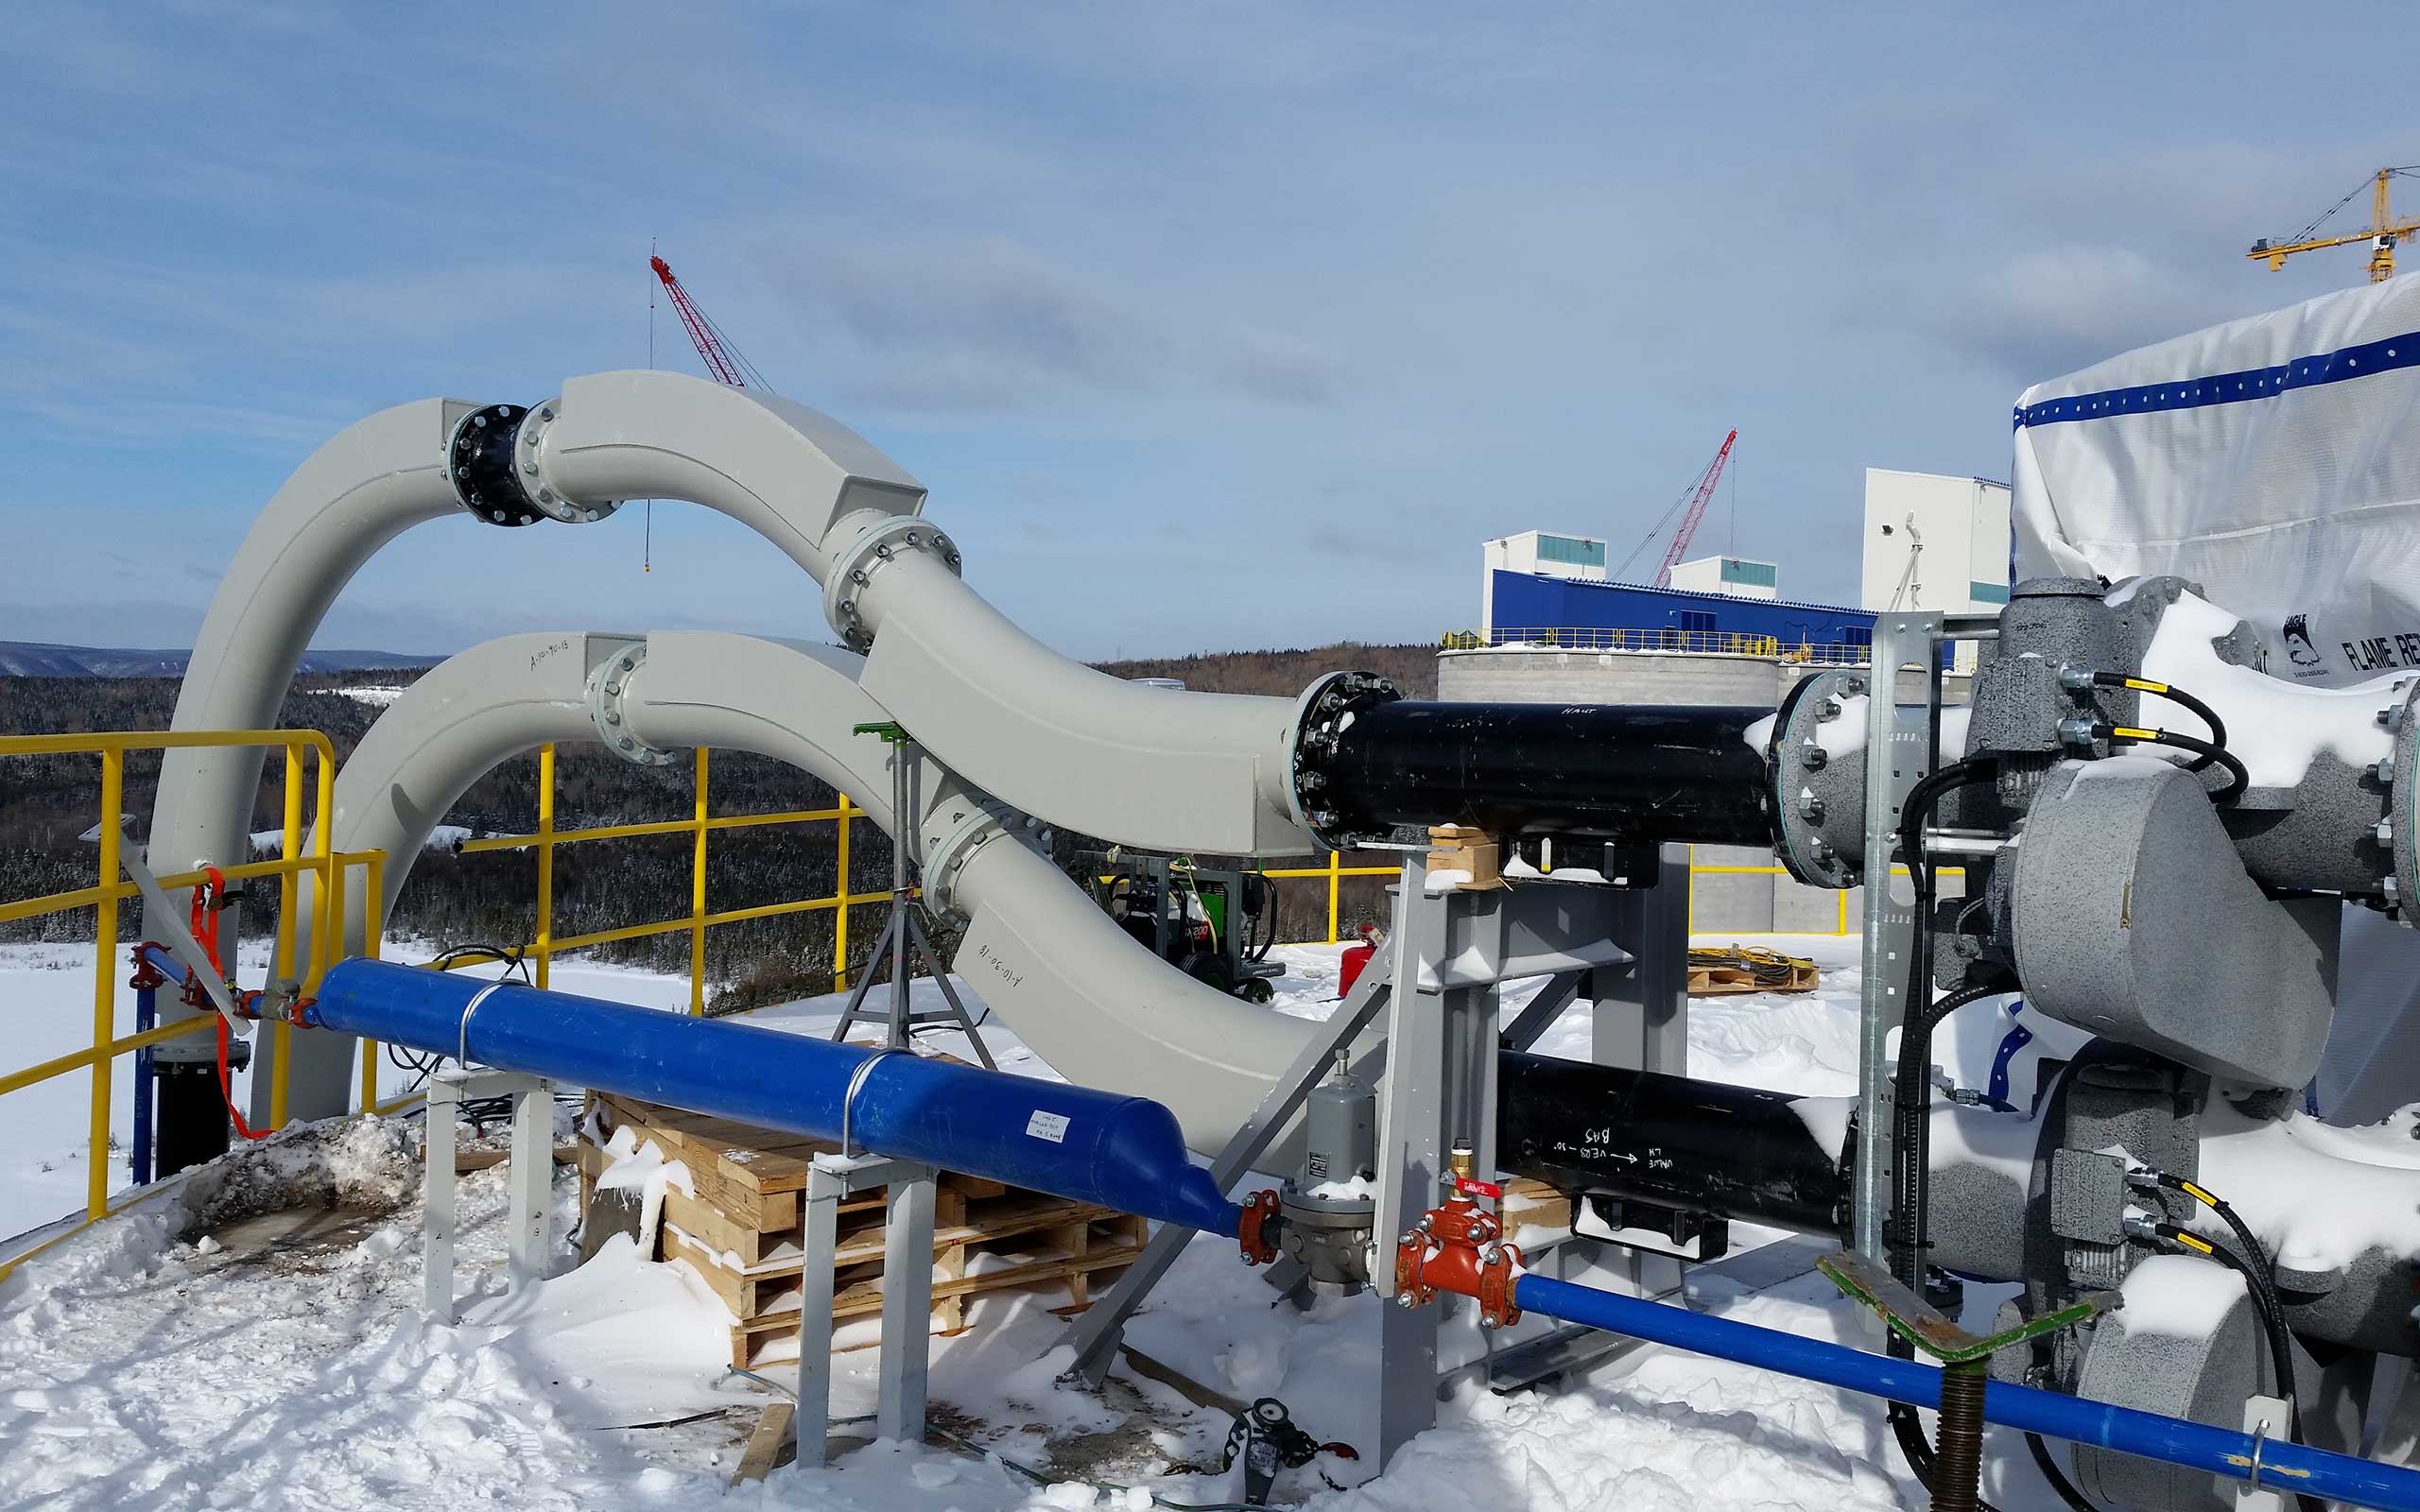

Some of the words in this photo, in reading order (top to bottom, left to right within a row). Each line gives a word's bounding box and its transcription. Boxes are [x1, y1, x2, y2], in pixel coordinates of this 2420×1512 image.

[2342, 637, 2398, 671] FLAME
[1584, 1127, 1610, 1144] BAS
[1581, 1147, 1607, 1159] VERS
